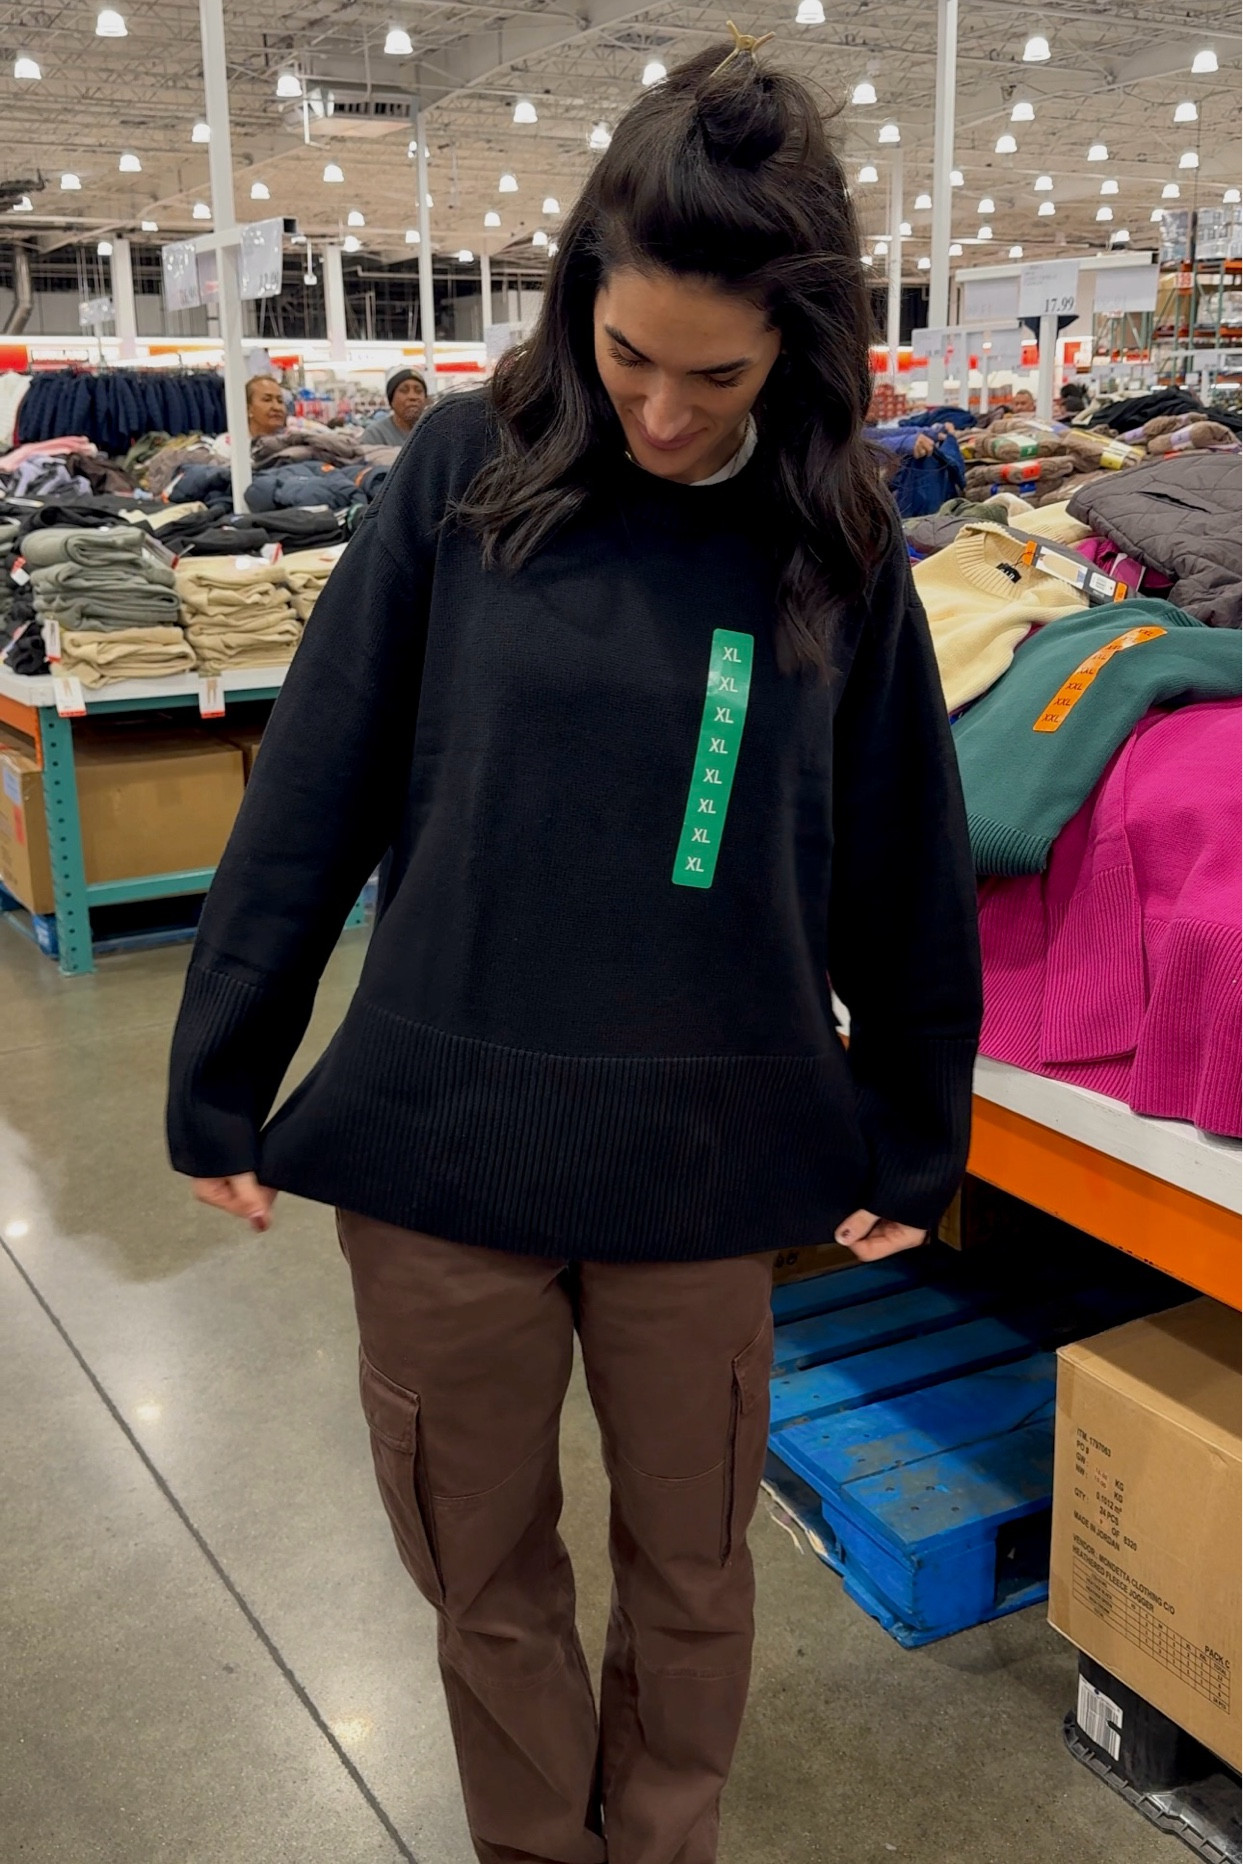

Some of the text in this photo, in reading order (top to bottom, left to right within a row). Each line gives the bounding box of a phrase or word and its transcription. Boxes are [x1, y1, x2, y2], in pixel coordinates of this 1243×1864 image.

[1044, 296, 1075, 313] 17.99
[722, 646, 742, 663] XL
[718, 676, 739, 693] XL
[1065, 682, 1083, 691] XXL
[1053, 698, 1071, 707] XXL
[714, 707, 734, 724] XL
[1041, 713, 1059, 723] XXL
[709, 737, 729, 754] XL
[703, 768, 723, 785] XL
[697, 798, 717, 814] XL
[691, 827, 711, 844] XL
[684, 856, 704, 873] XL
[1076, 1439, 1085, 1452] PO
[1114, 1479, 1124, 1492] KG
[1113, 1491, 1123, 1504] KG
[1074, 1487, 1086, 1501] QTY
[1099, 1505, 1106, 1517] 24
[1107, 1510, 1119, 1526] PCS
[1073, 1510, 1120, 1552] MADE IN JORDAN
[1111, 1527, 1120, 1538] OF
[1072, 1545, 1105, 1576] HEATHERED
[1105, 1570, 1128, 1593] FLEECE
[1129, 1589, 1154, 1613] JOGGER
[1098, 1553, 1131, 1584] MONDETTA
[1131, 1578, 1163, 1607] CLOTHING
[1163, 1601, 1175, 1615] C/O
[1204, 1645, 1224, 1665] PACK
[1225, 1659, 1231, 1669] C
